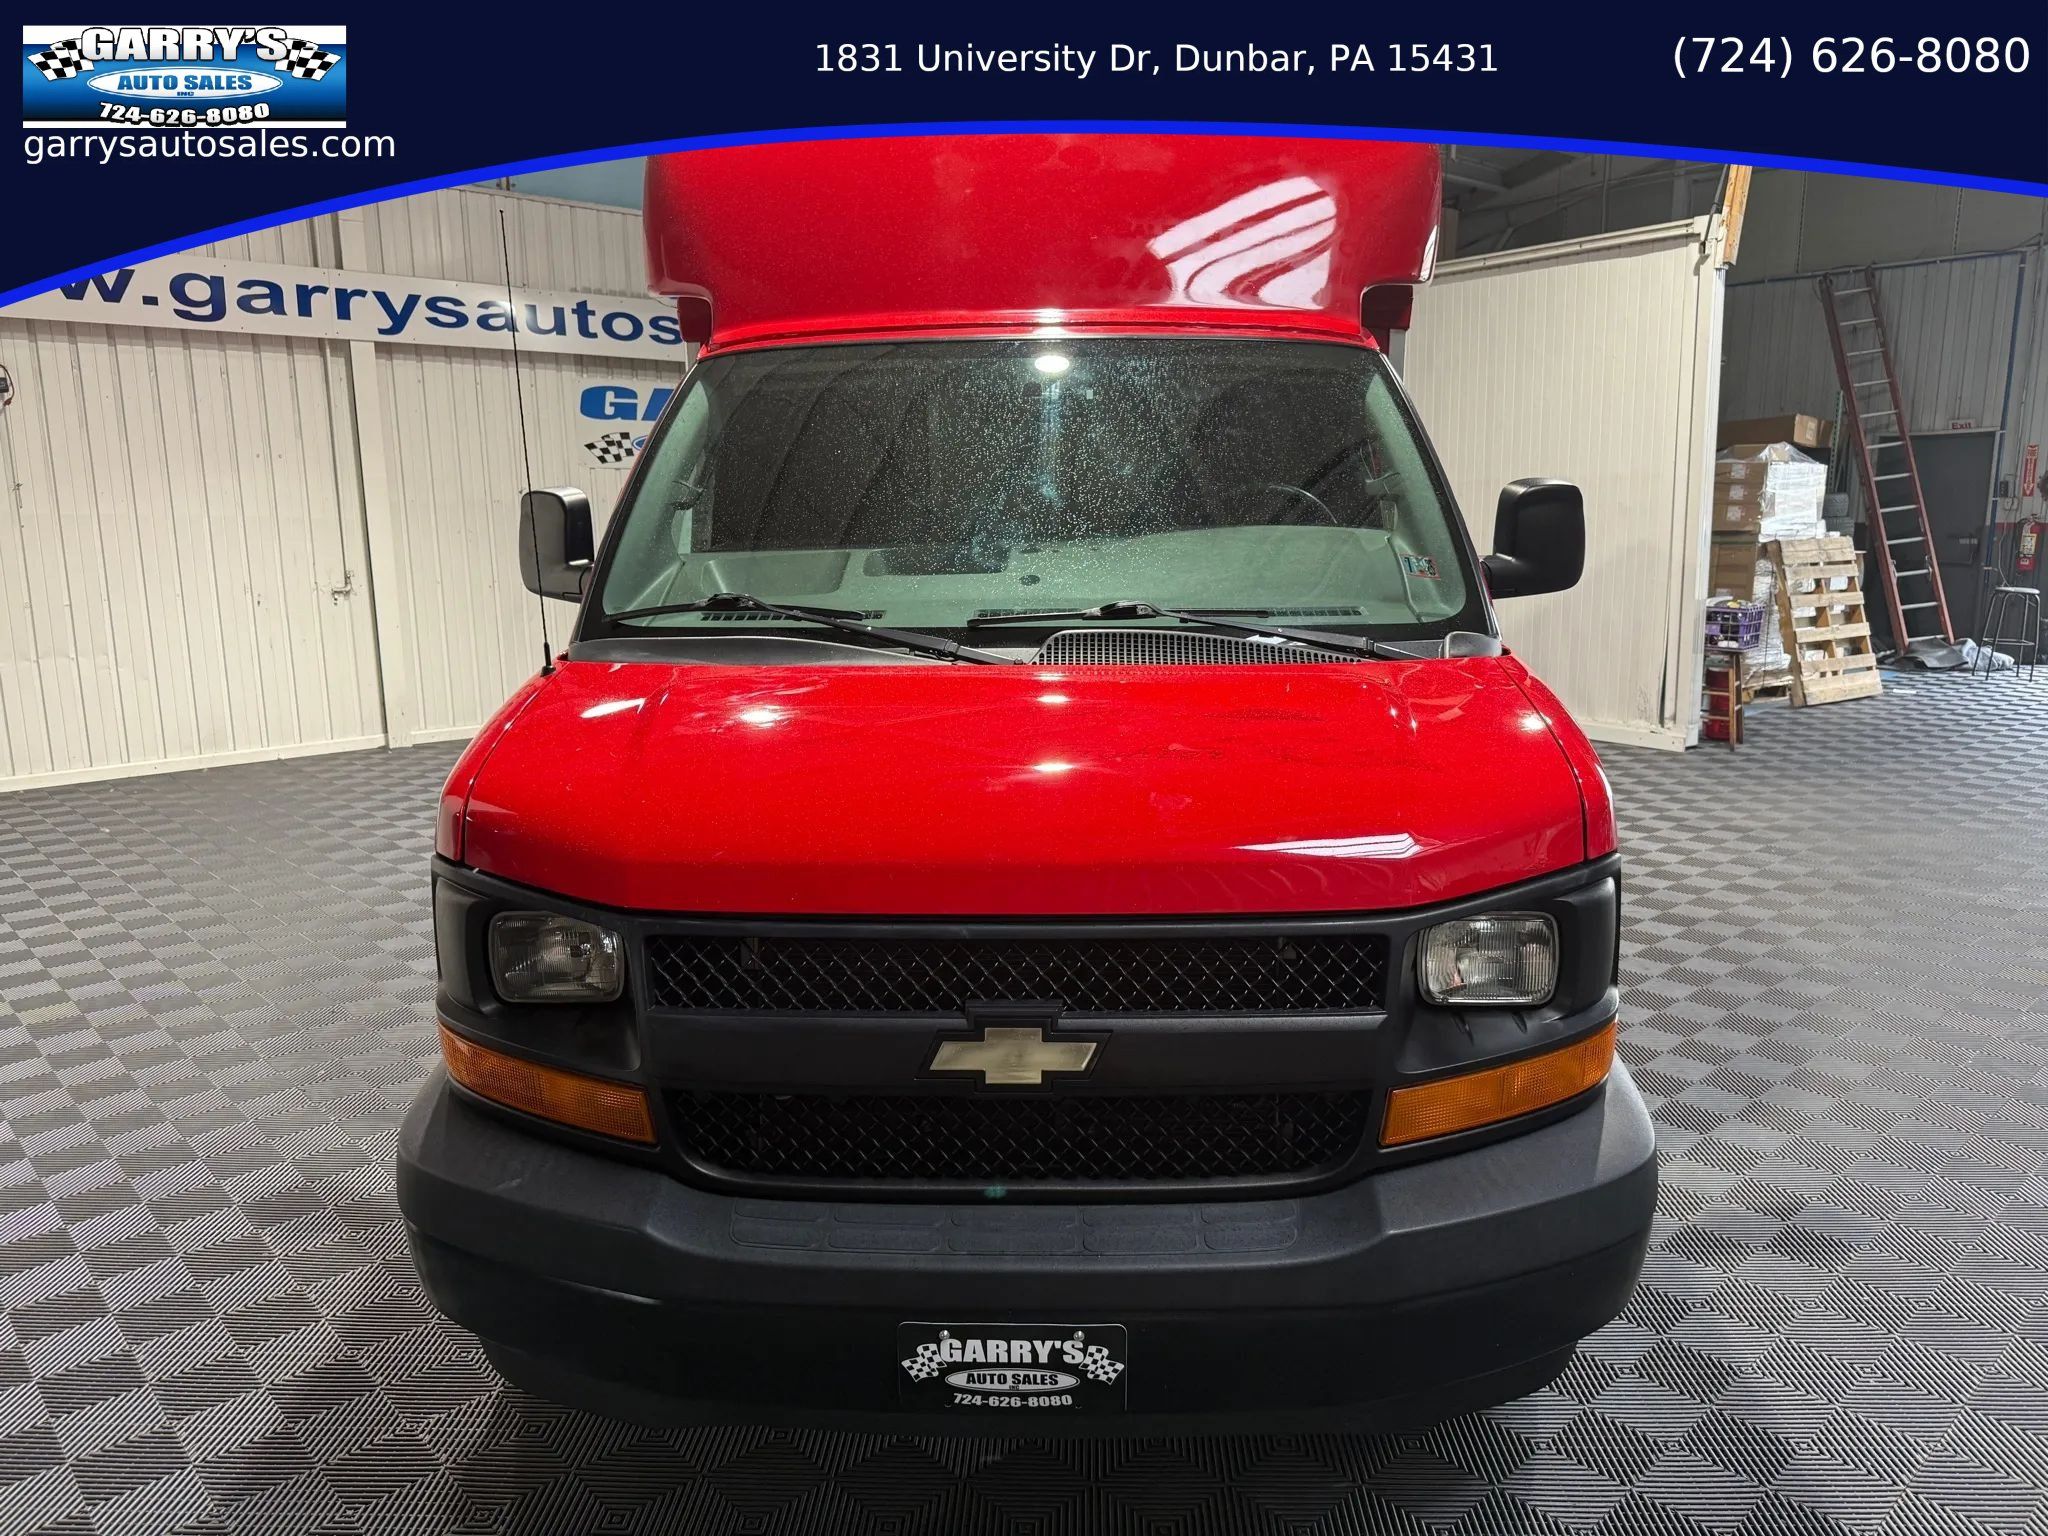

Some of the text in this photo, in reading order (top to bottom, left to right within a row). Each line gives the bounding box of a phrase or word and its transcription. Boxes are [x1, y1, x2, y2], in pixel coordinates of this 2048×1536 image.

[940, 1338, 1084, 1364] GARRY'S
[965, 1373, 1059, 1386] AUTO SALES
[953, 1393, 1073, 1407] 724-626-8080
